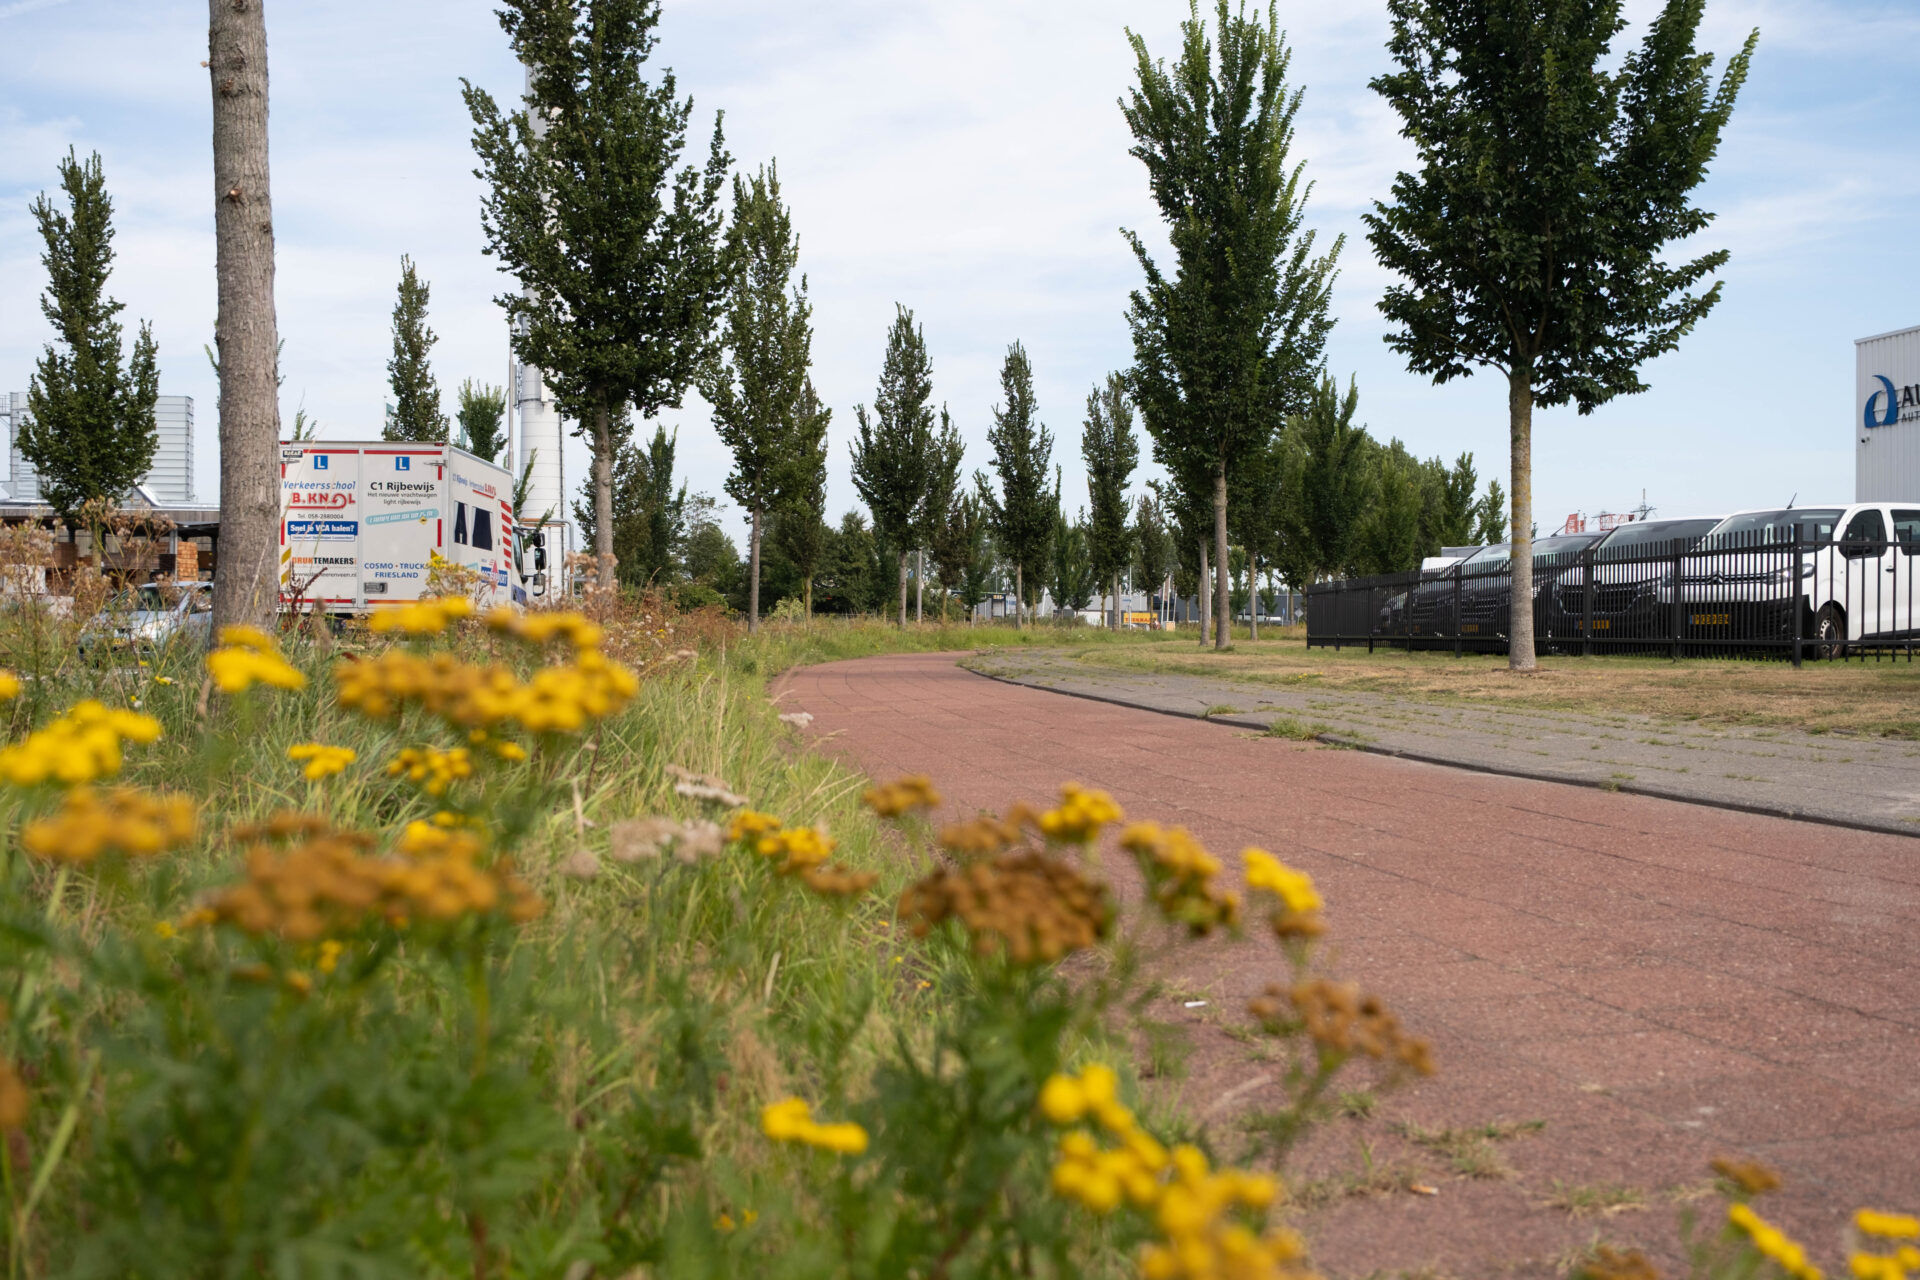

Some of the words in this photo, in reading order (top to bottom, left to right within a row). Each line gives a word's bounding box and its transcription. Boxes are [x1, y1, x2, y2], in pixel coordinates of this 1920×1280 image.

[317, 456, 326, 469] L
[399, 457, 407, 470] L
[370, 481, 383, 491] C1
[386, 481, 435, 492] Rijbewijs
[364, 562, 394, 570] COSMO
